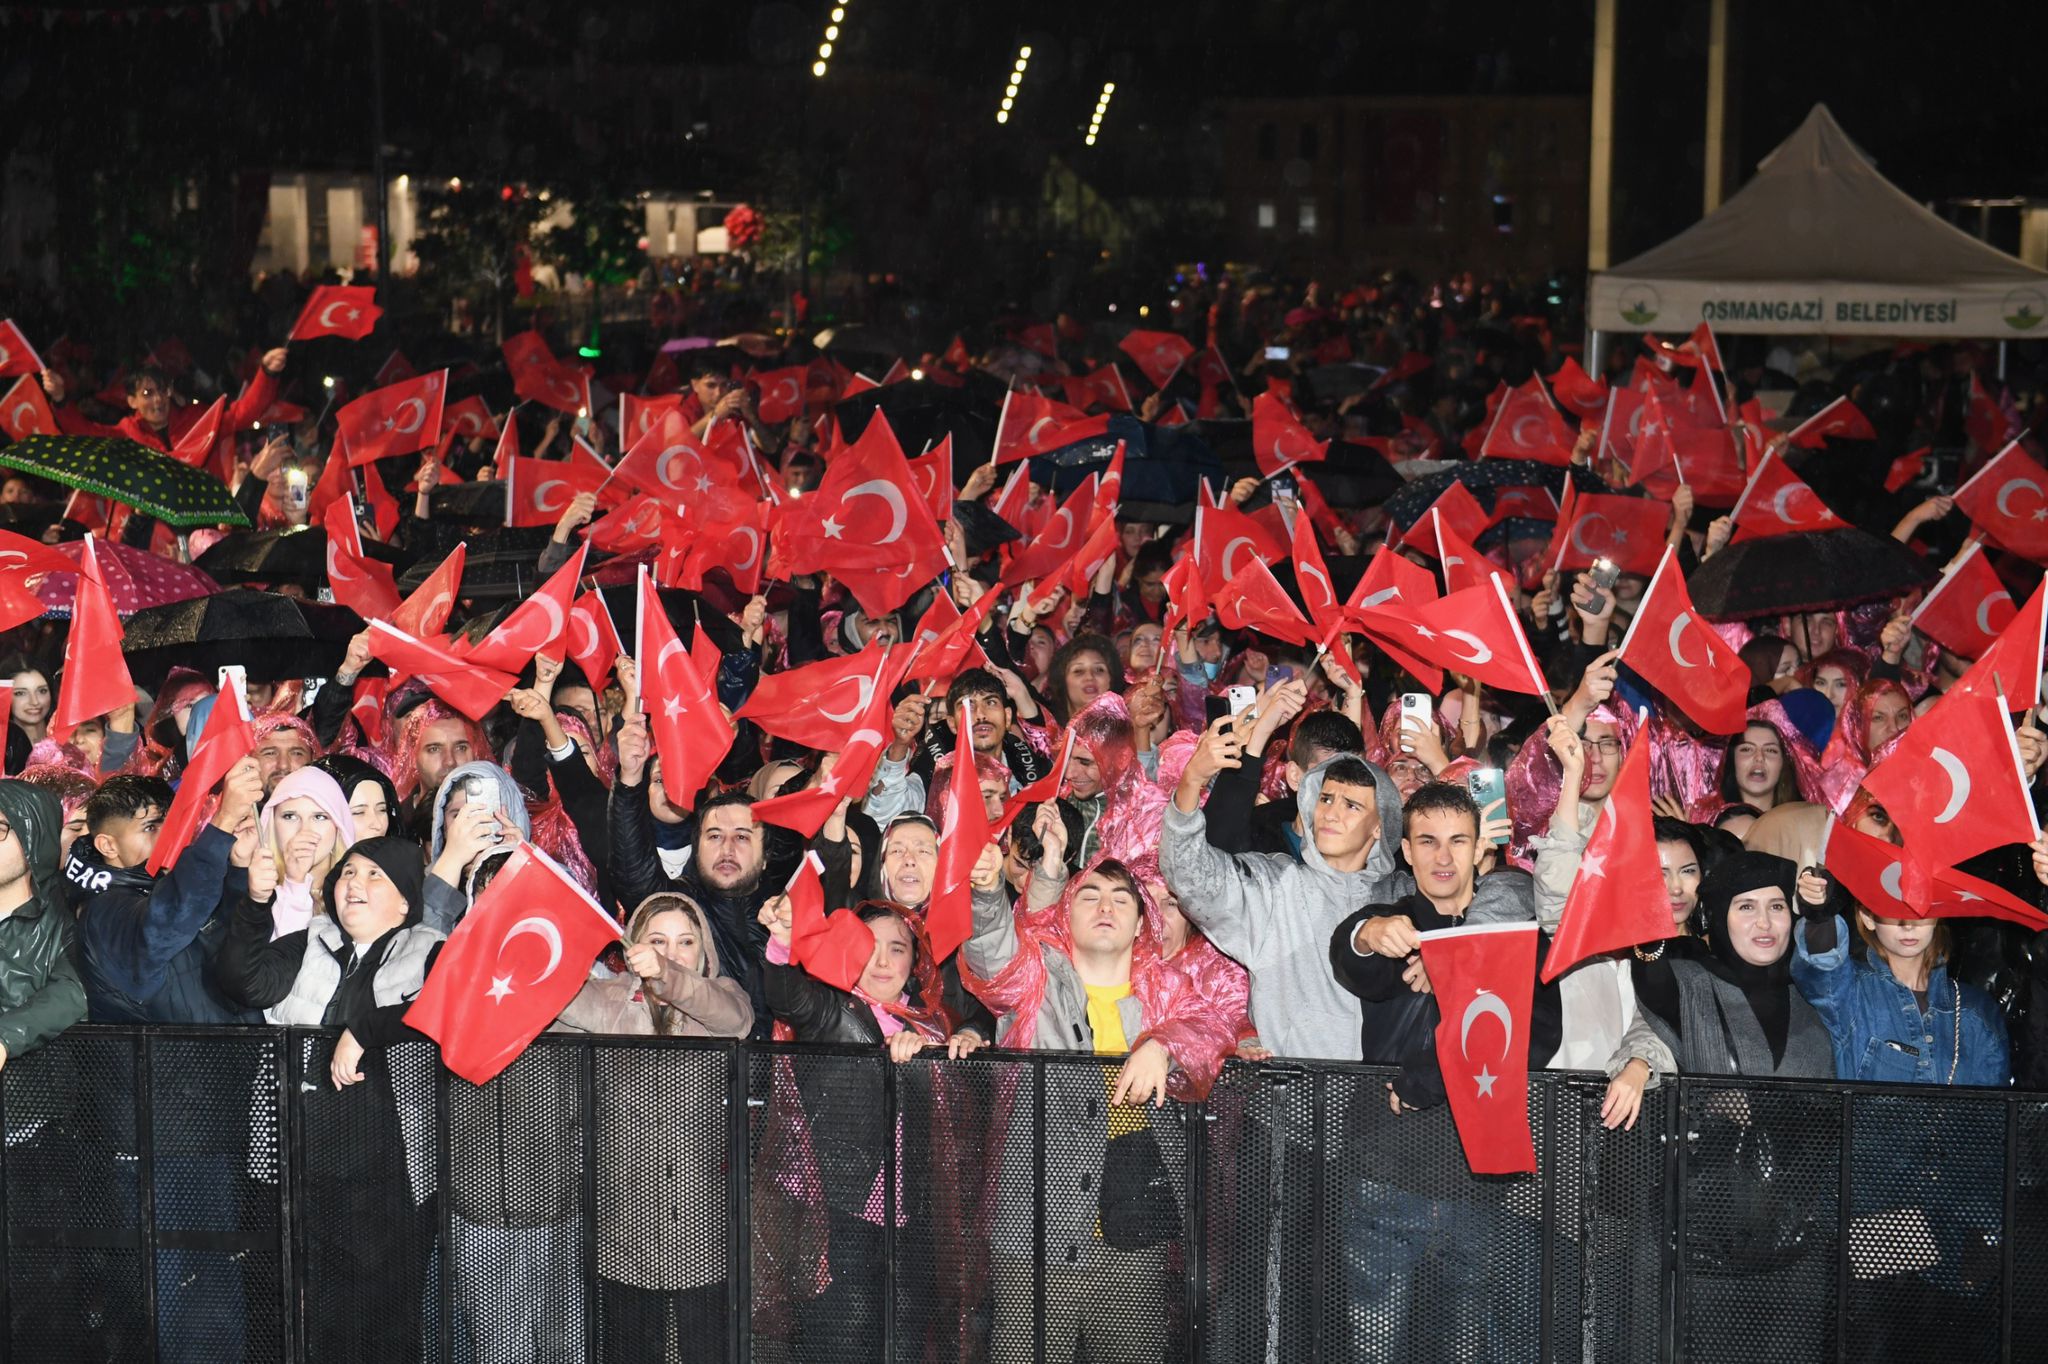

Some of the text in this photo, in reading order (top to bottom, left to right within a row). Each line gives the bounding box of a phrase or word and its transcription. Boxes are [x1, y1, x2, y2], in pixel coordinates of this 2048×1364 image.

[1702, 298, 1957, 324] OSMANGAZİ BELEDİYESİ
[1014, 741, 1037, 784] ONCLER
[64, 854, 112, 891] EAR
